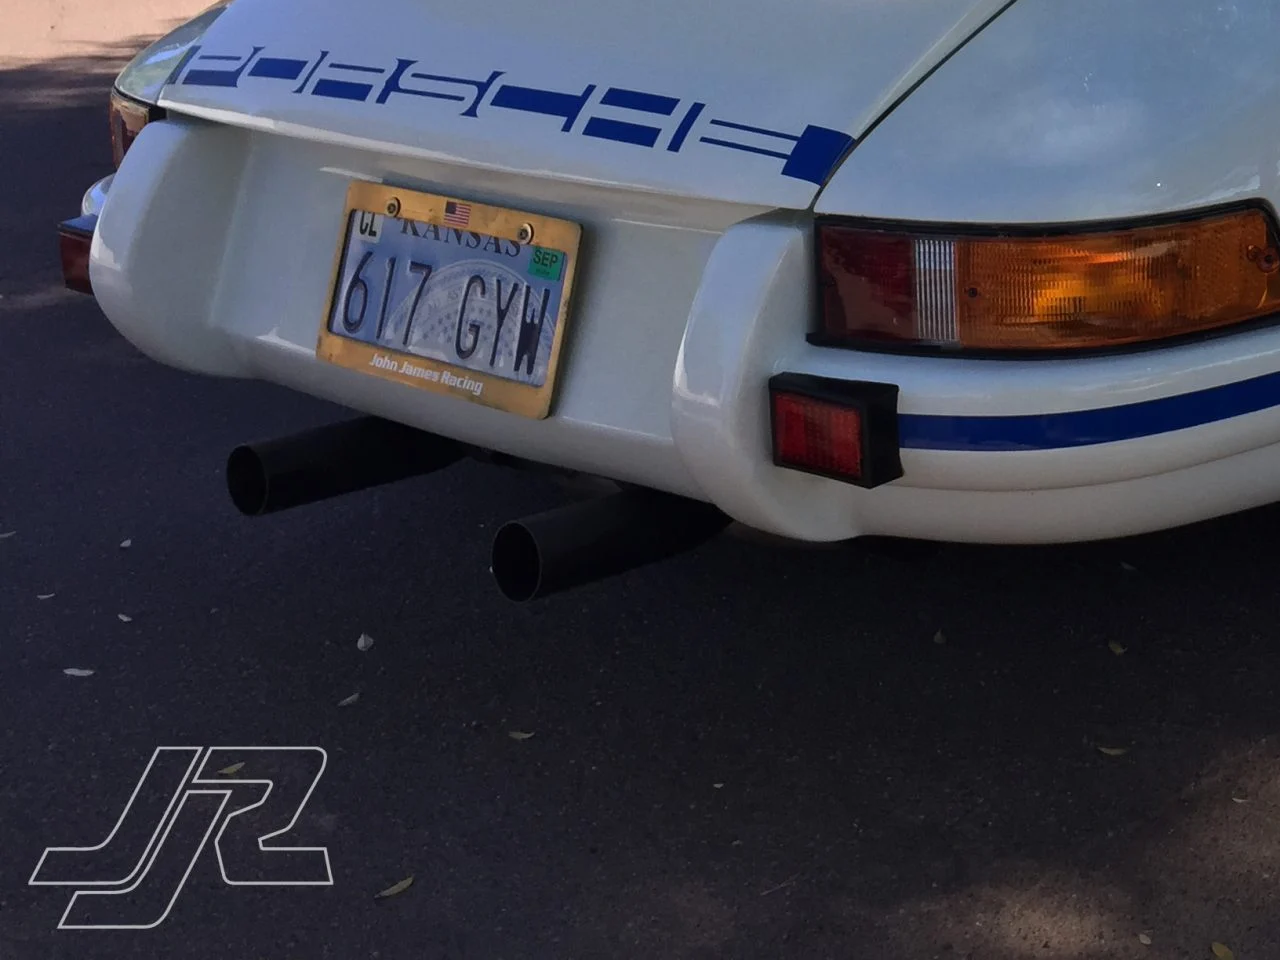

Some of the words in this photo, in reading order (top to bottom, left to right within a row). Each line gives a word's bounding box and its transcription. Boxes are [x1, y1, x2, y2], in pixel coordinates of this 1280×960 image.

[170, 44, 812, 178] PORSCHE
[532, 249, 559, 269] SEP
[342, 251, 432, 346] 617
[455, 274, 550, 376] GYW
[369, 353, 398, 371] John
[398, 361, 440, 382] James
[440, 370, 484, 395] Racing
